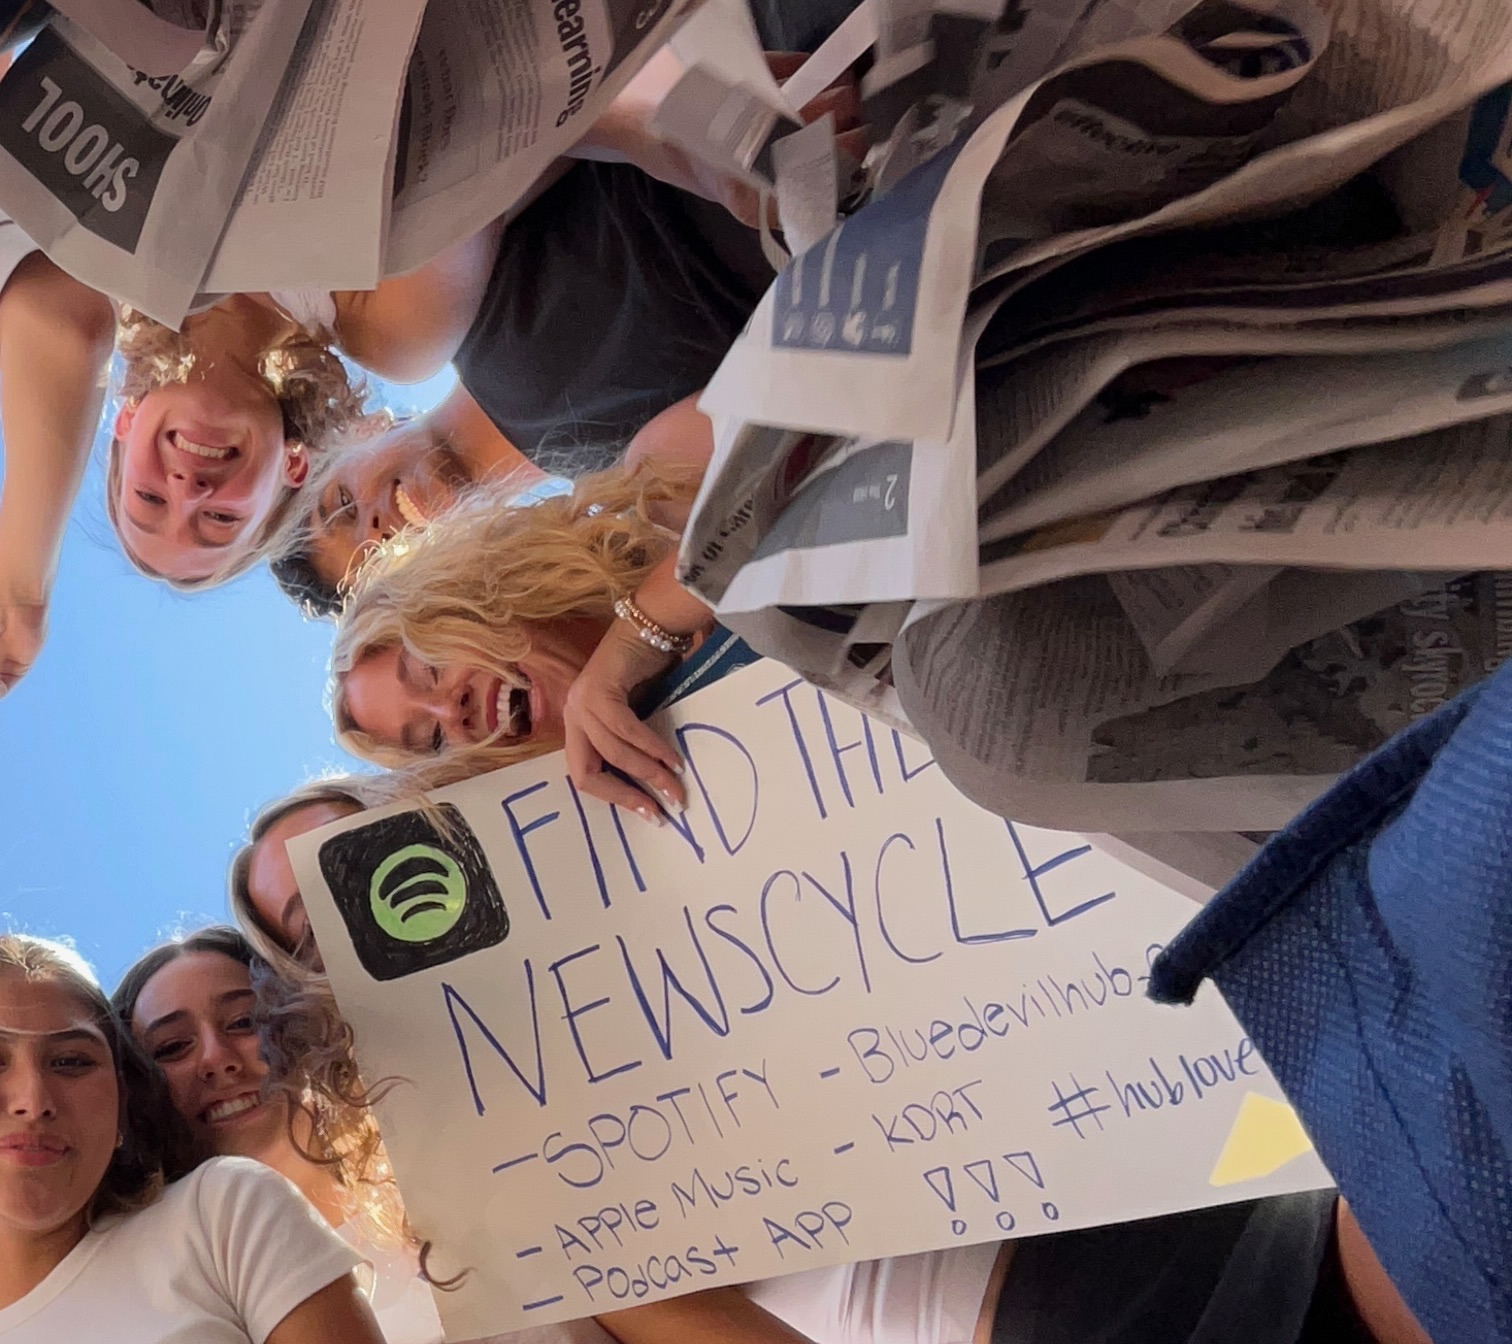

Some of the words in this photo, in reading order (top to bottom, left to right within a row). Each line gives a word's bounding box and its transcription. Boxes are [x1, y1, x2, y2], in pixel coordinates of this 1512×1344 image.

[21, 76, 140, 213] SHOOL
[884, 473, 898, 511] 2
[442, 818, 1116, 1117] NEWSCYCLE
